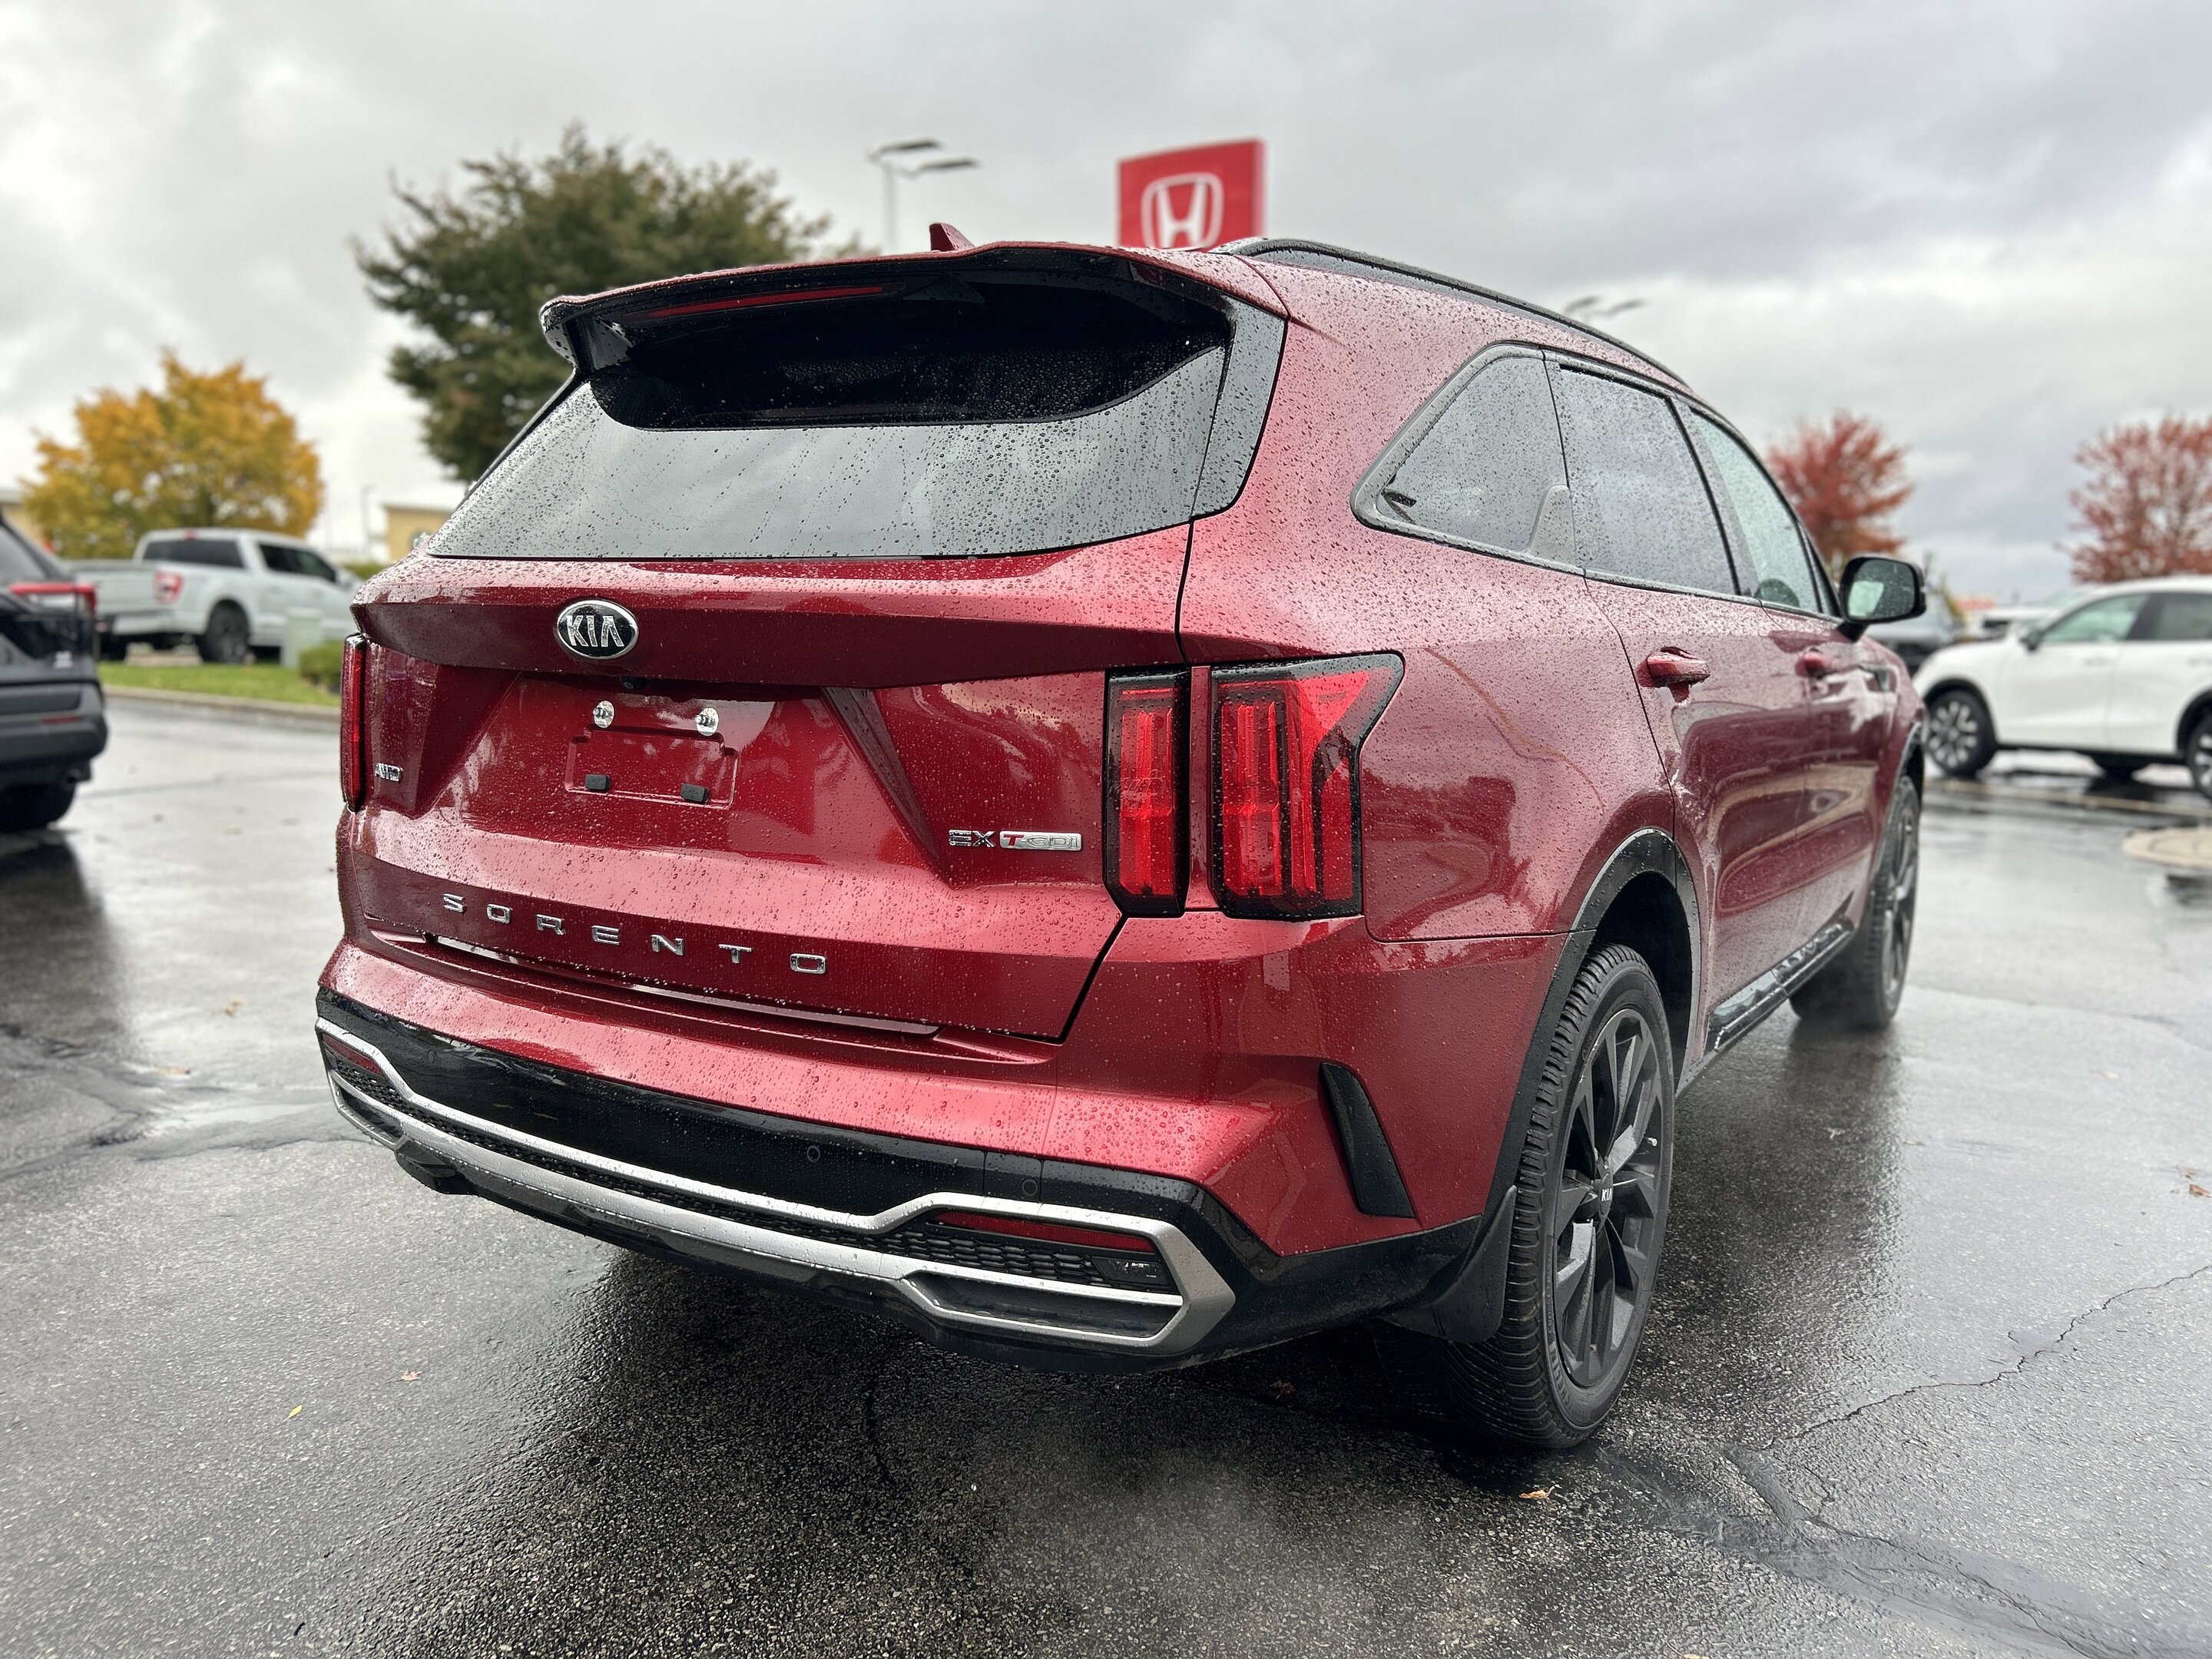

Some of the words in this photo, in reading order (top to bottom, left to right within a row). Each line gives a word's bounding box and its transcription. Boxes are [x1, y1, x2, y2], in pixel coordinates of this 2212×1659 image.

[565, 614, 625, 647] KIA
[948, 829, 996, 848] EX
[442, 892, 828, 975] SORENTO
